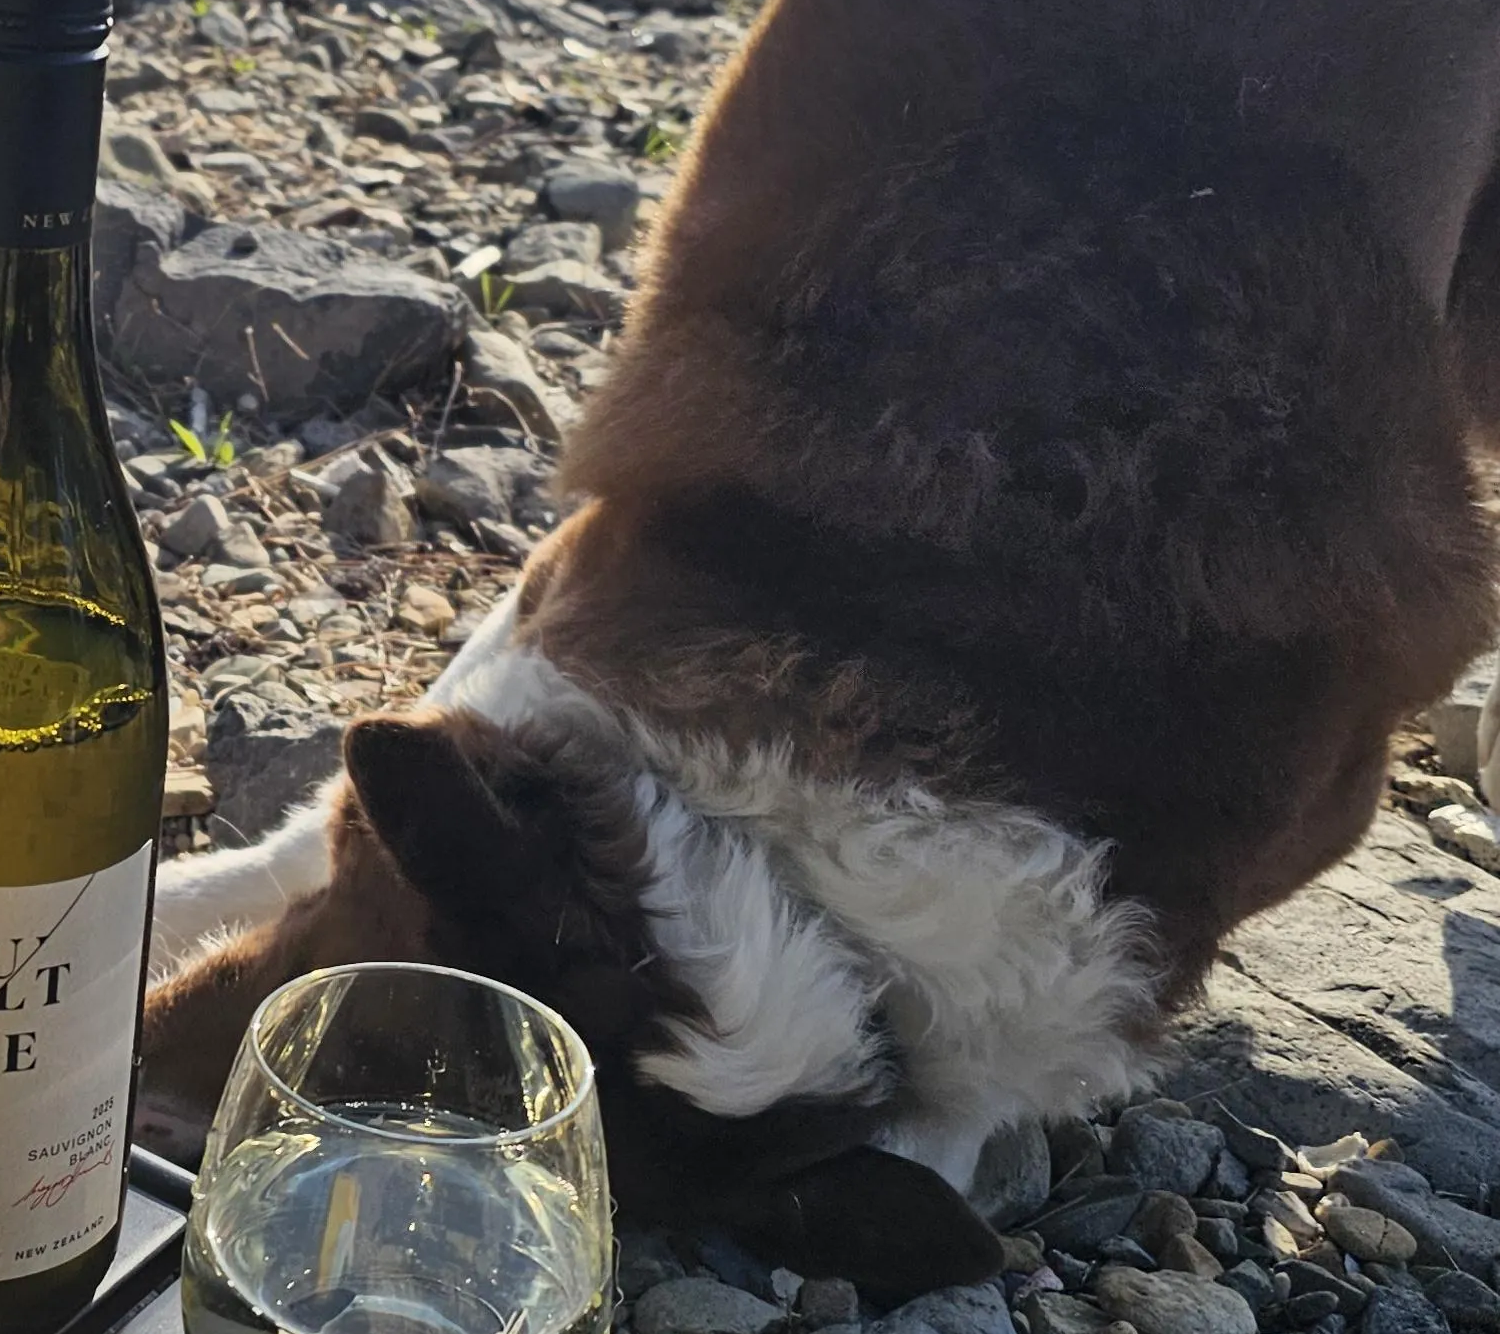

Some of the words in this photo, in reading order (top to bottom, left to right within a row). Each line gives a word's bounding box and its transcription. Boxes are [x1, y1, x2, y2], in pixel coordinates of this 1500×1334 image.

[23, 212, 74, 228] NEW
[27, 1118, 113, 1162] SAUVIGNON
[69, 1134, 111, 1166] BLANC
[14, 1244, 48, 1261] NEW
[52, 1215, 105, 1250] ZEALAND
